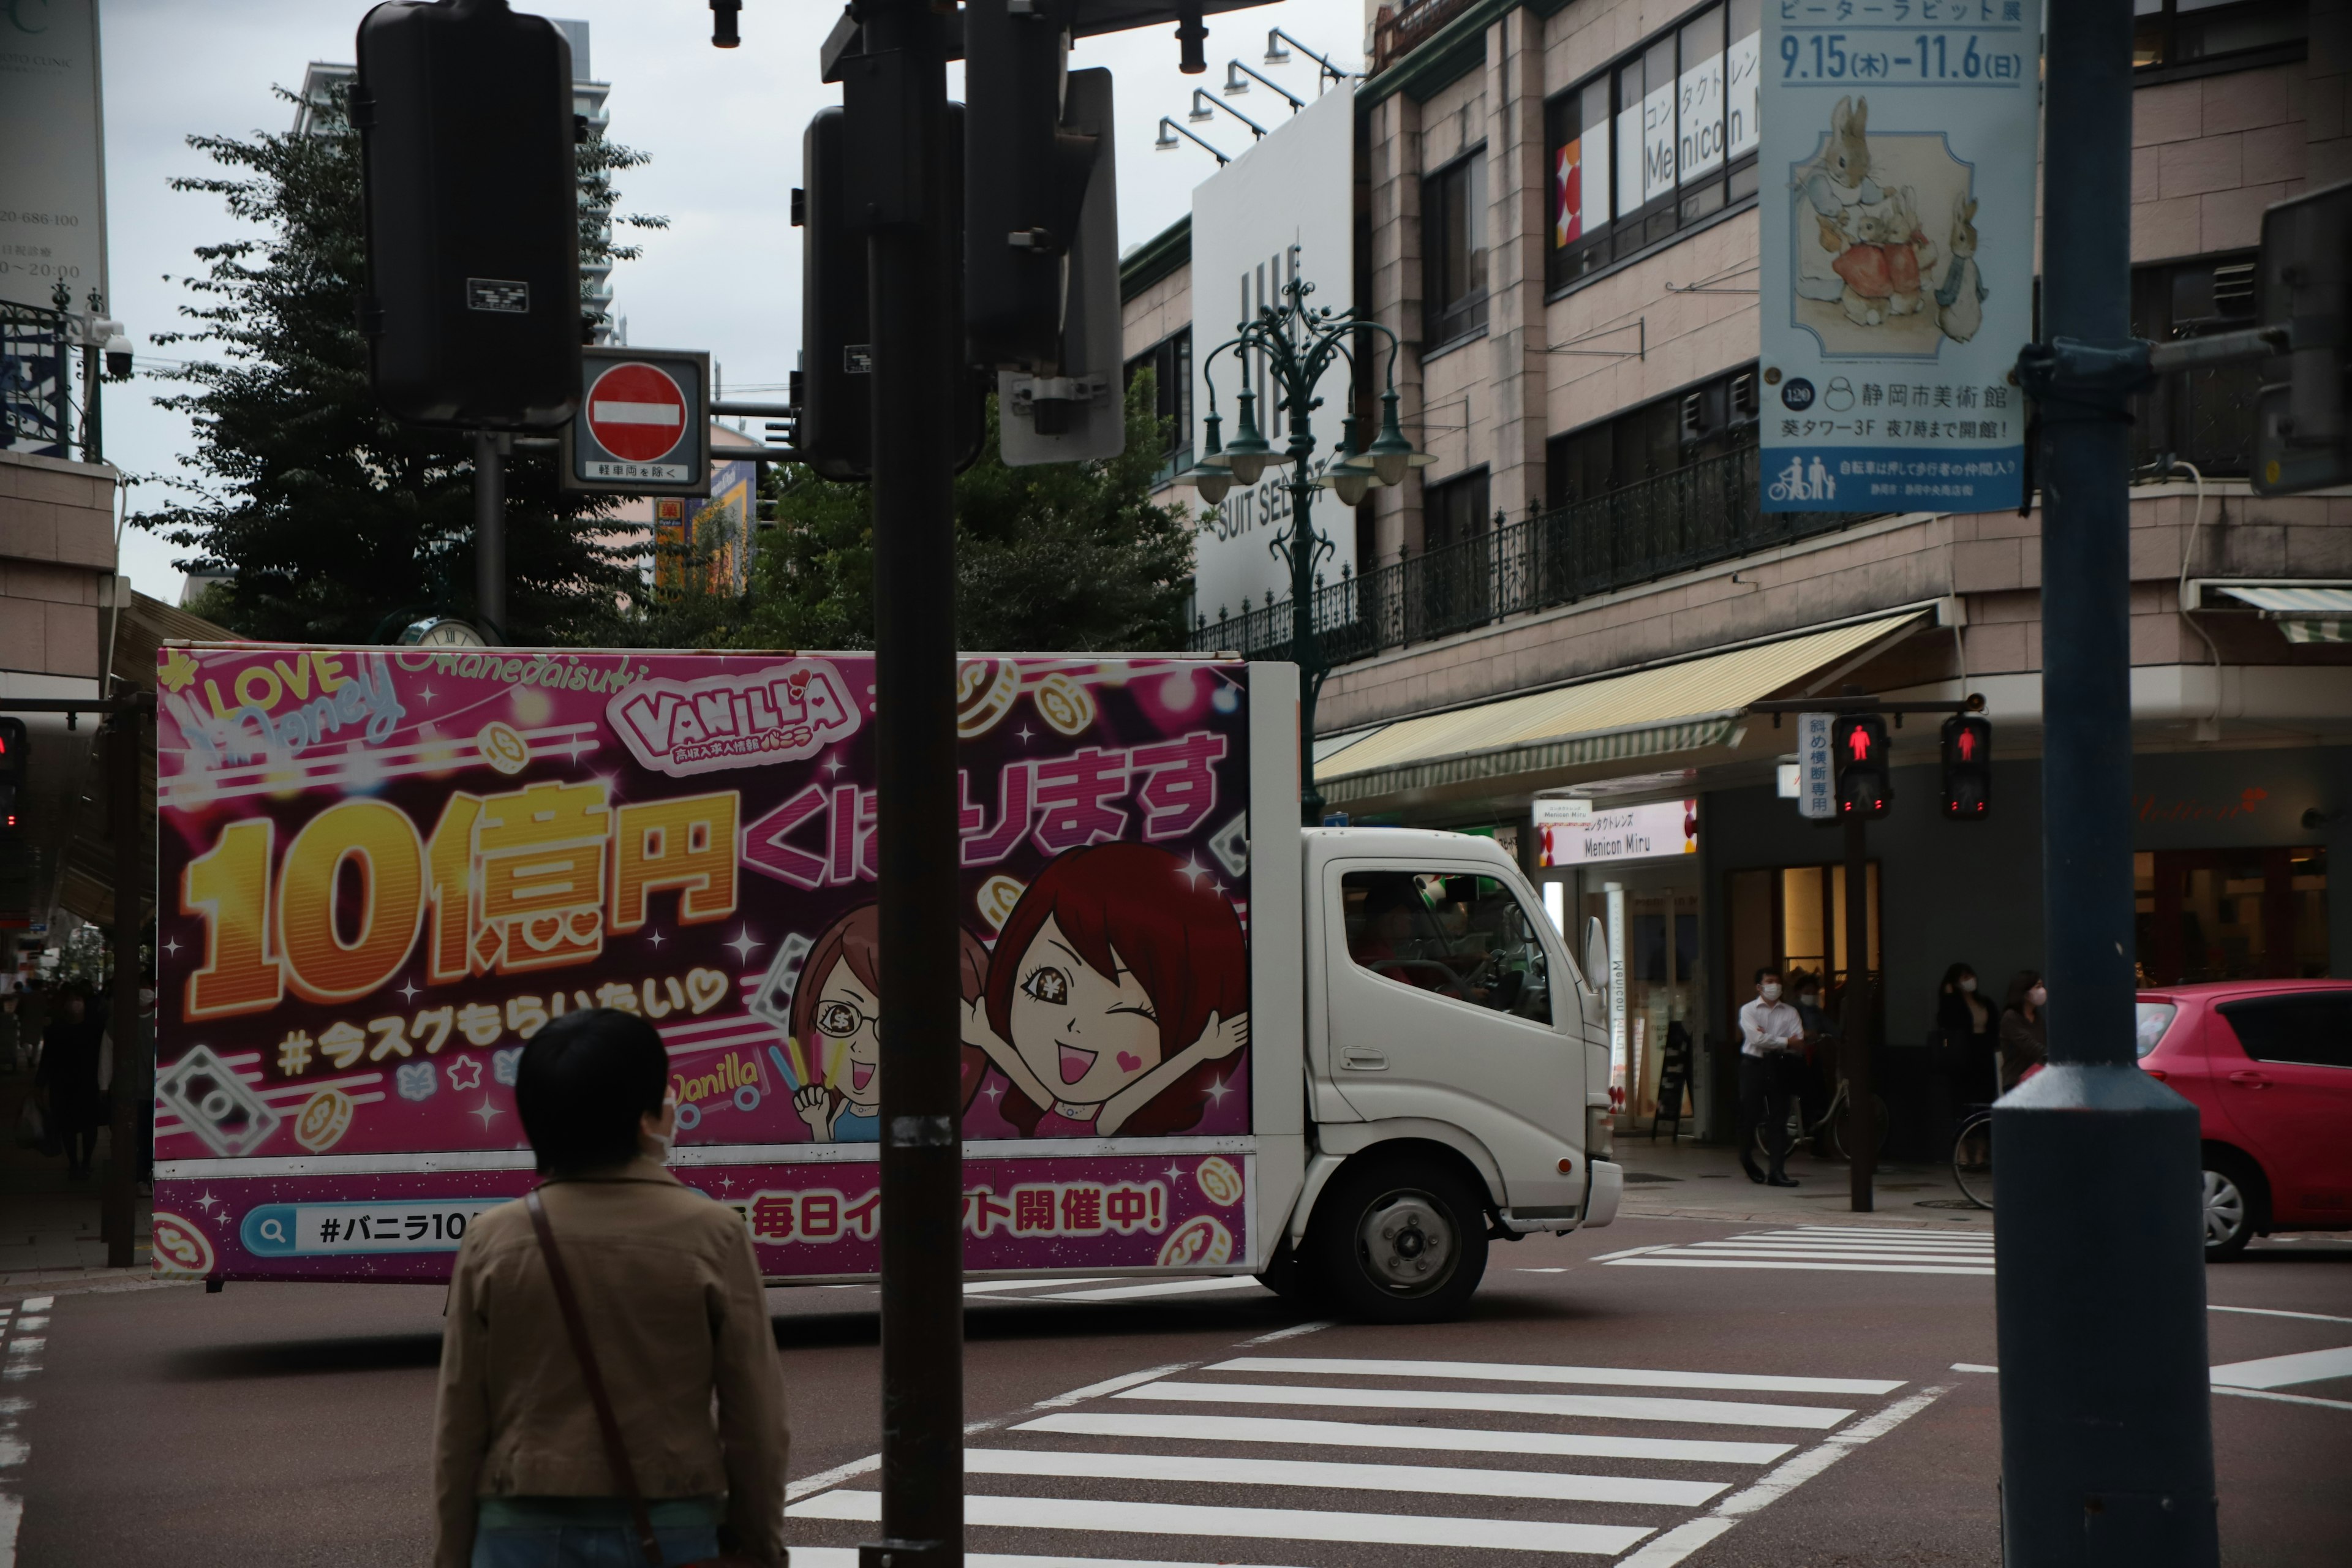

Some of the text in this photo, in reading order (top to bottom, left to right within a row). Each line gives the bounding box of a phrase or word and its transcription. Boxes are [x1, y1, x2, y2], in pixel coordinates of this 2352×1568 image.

[1646, 51, 1760, 131] コンタクトレン
[1646, 107, 1743, 189] Menicon
[1862, 383, 2007, 409] 静岡市美術館
[1781, 419, 1876, 438] 葵タワー3F
[598, 463, 676, 478] 軽車両を除く
[1218, 458, 1325, 542] SUIT SELT
[204, 652, 353, 722] LOVE
[621, 671, 849, 757] VANILLA
[674, 726, 814, 764] 高収入求人情報 バニラ
[1809, 718, 1828, 812] 斜め横断専用
[1585, 833, 1650, 858] Menicon Miru
[320, 1212, 481, 1243] #バニラ10
[752, 1186, 1163, 1238] 毎日イト開催中!
